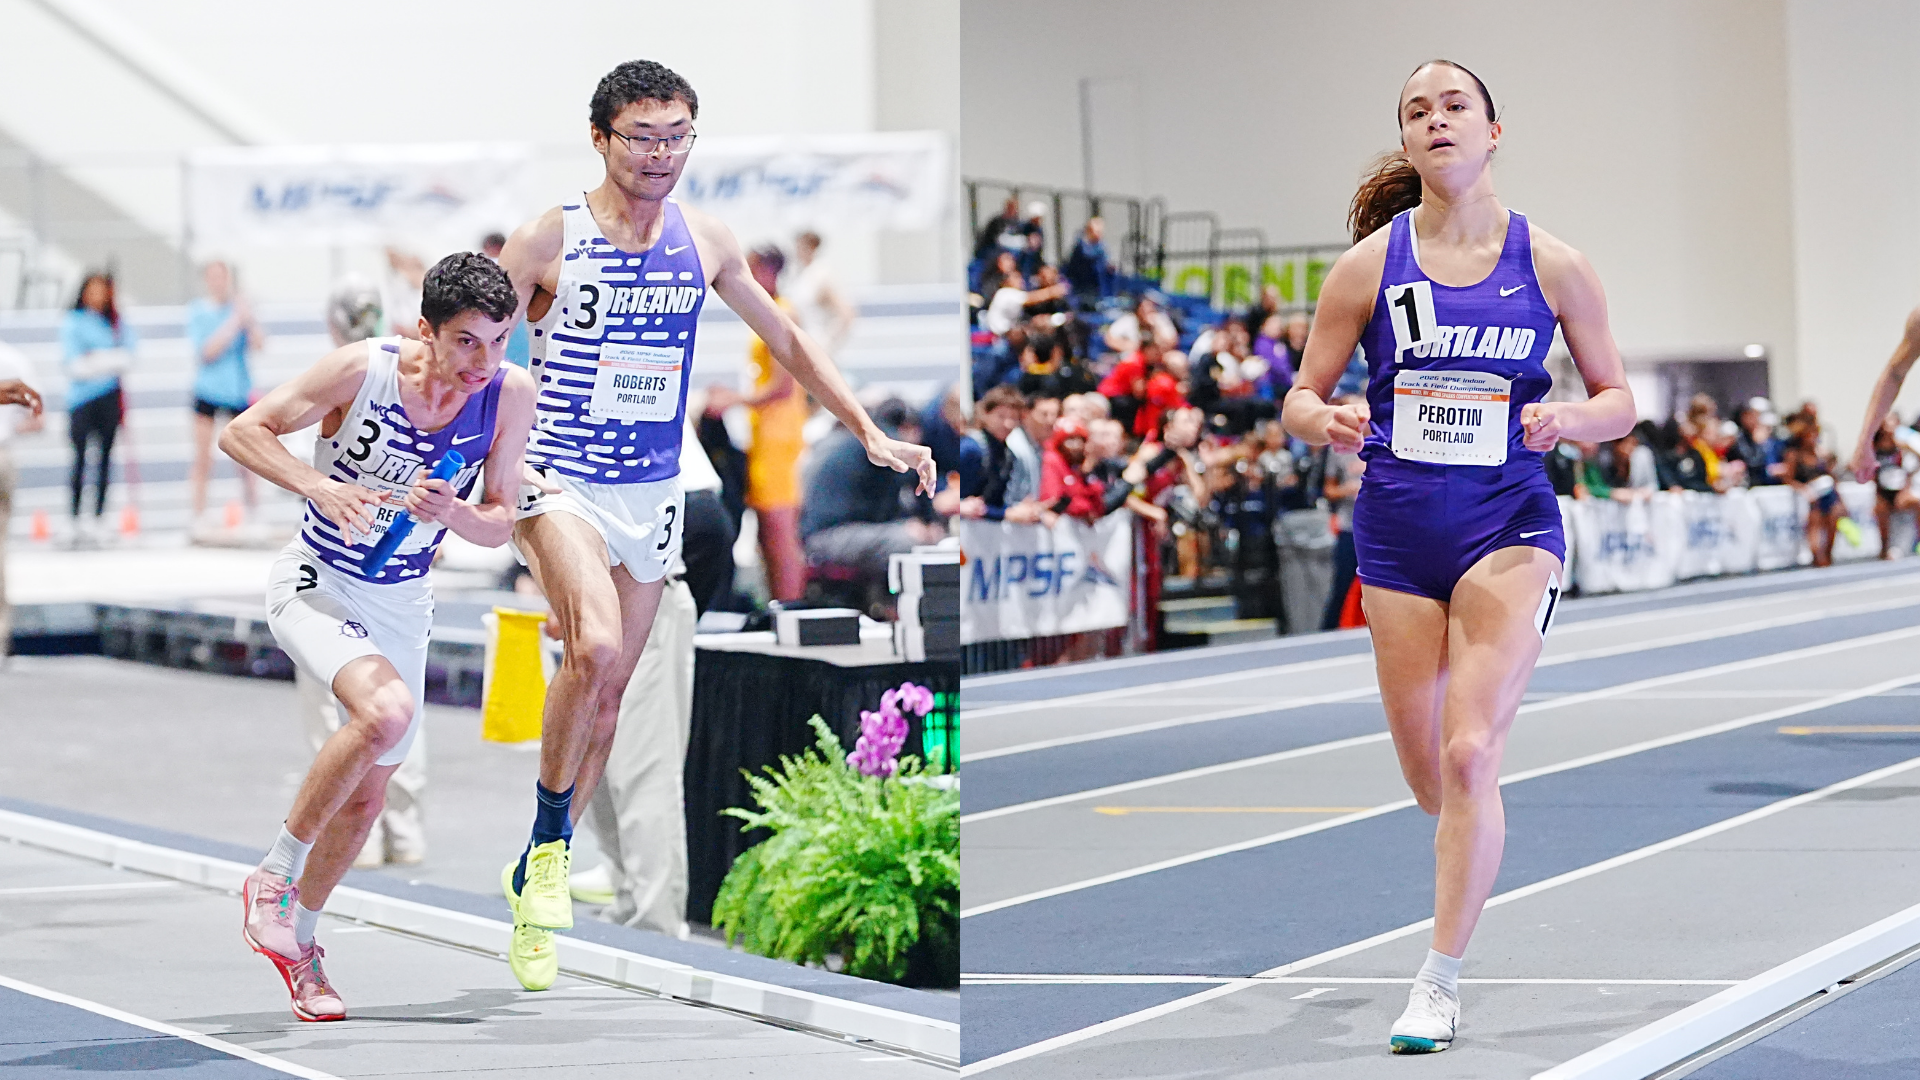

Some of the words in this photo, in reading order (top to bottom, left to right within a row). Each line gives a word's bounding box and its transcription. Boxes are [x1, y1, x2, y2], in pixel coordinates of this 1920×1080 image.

[574, 284, 600, 330] 3
[606, 285, 697, 314] RTLAND
[1393, 287, 1422, 343] 1
[1395, 325, 1536, 363] RTLAND
[613, 374, 667, 391] ROBERTS
[617, 393, 657, 405] PORTLAND
[1450, 385, 1504, 393] Championships
[1418, 404, 1483, 427] PEROTIN
[346, 418, 381, 462] 3
[1422, 429, 1474, 444] PORTLAND
[657, 505, 677, 550] 3
[968, 552, 1075, 602] MPSF
[1541, 586, 1559, 636] 1
